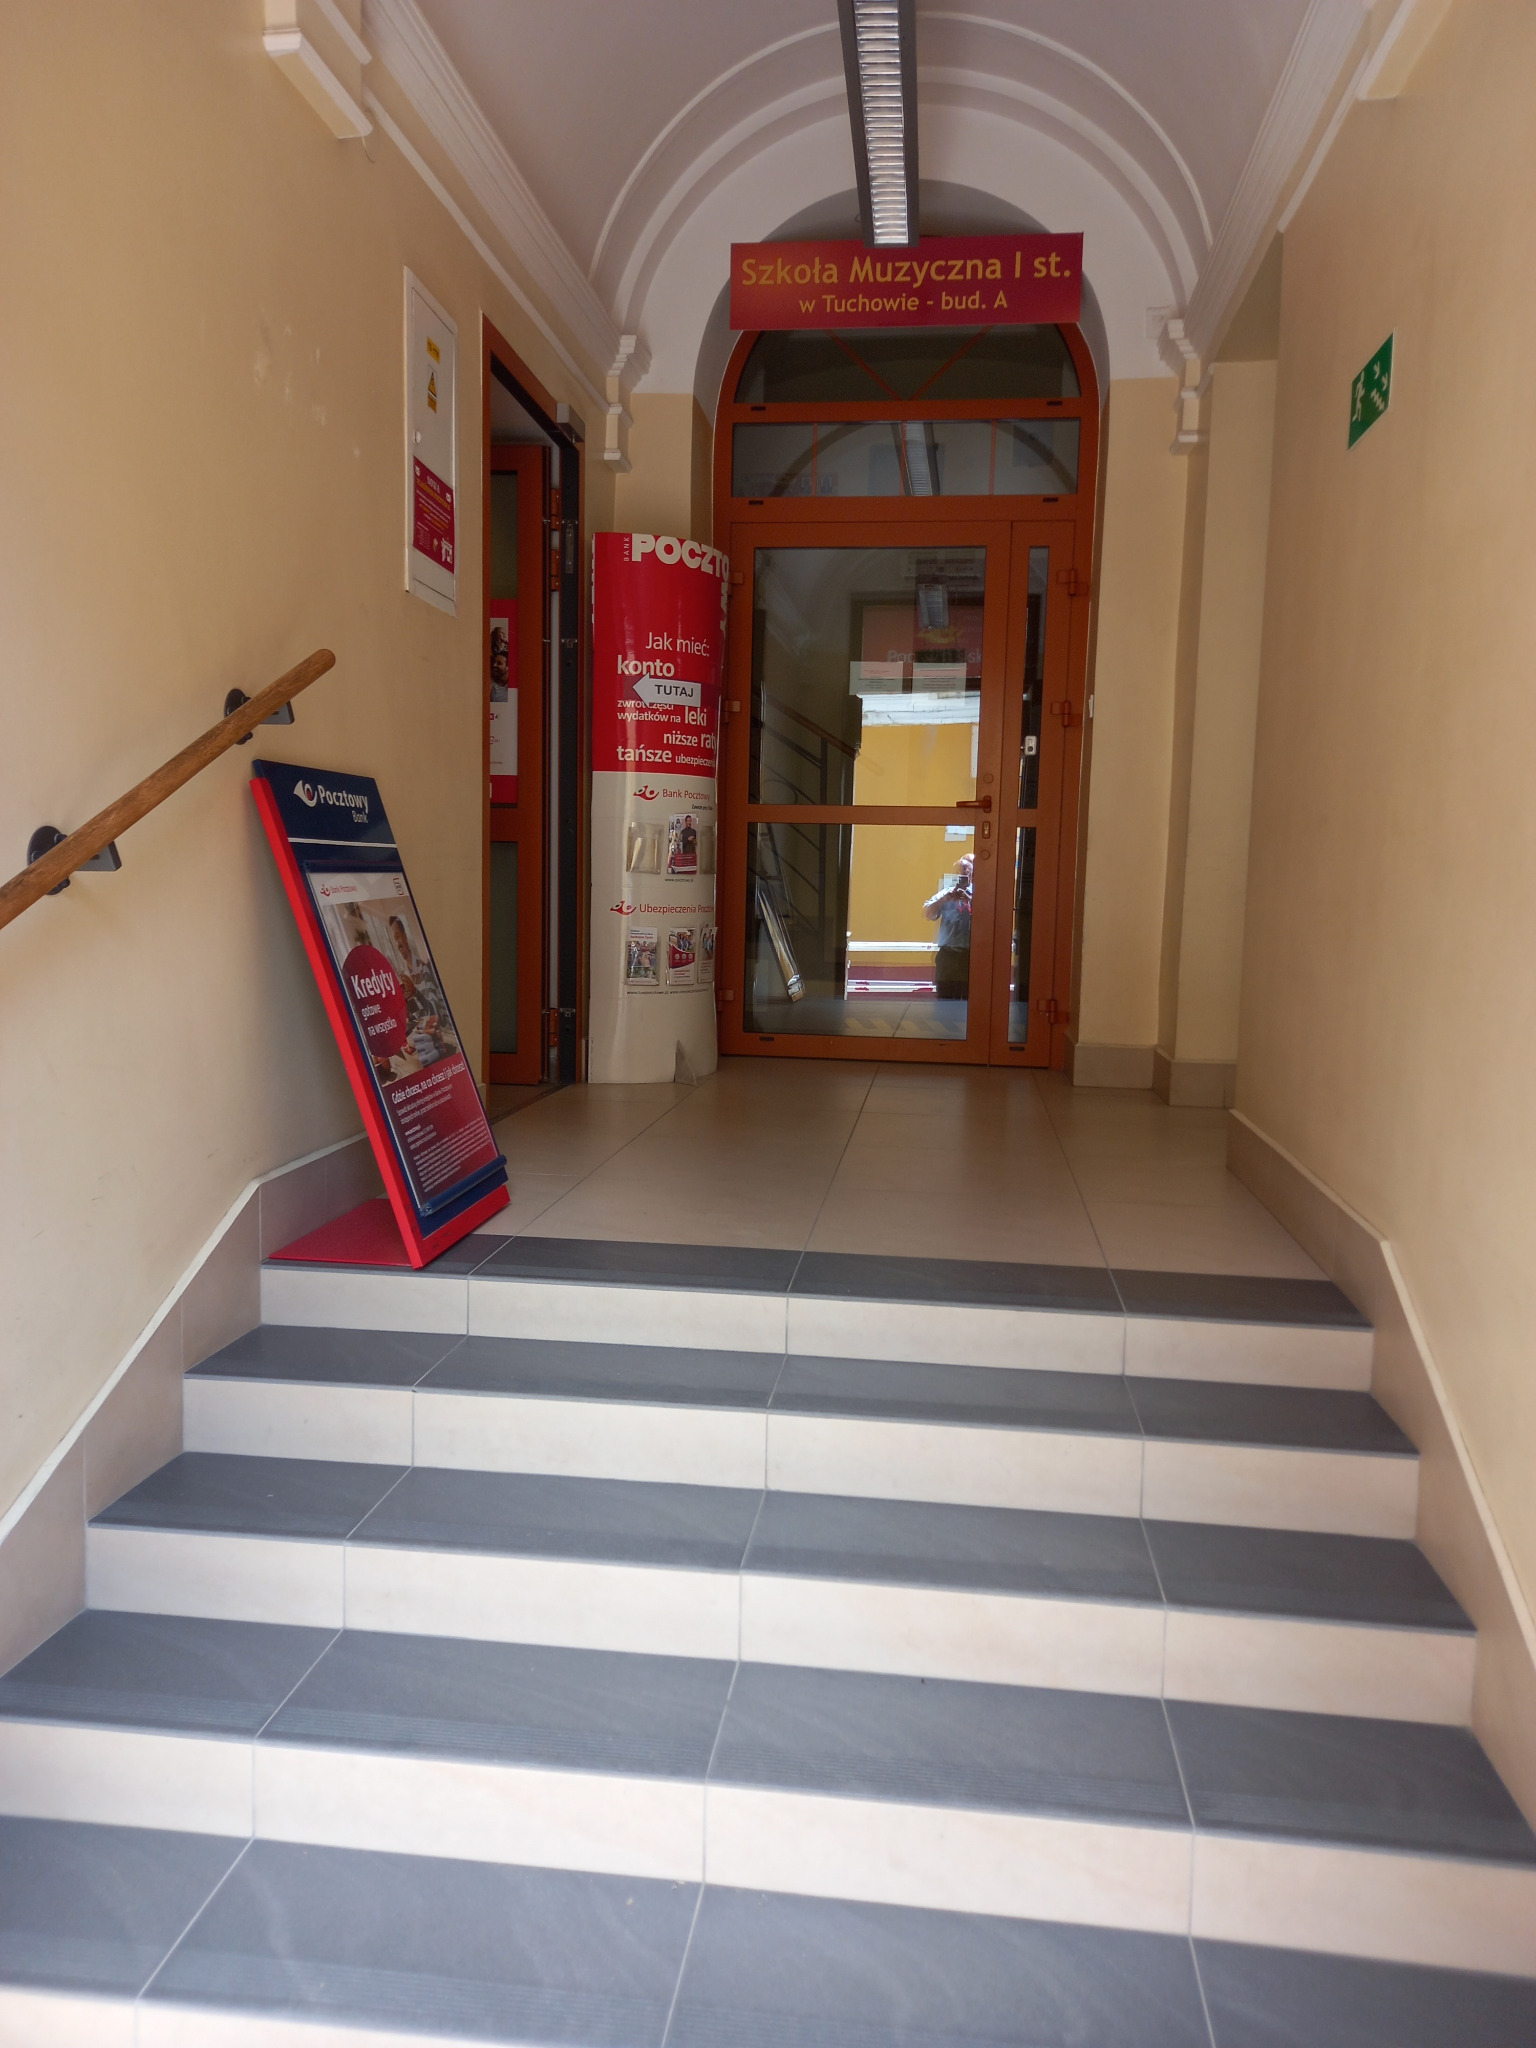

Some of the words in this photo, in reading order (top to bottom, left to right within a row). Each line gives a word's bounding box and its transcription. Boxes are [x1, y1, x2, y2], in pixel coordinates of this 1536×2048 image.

[741, 257, 838, 286] Szkoła
[848, 256, 1002, 289] Muzyczna
[1014, 251, 1021, 279] I
[1033, 252, 1072, 279] st.
[799, 300, 815, 314] w
[821, 292, 920, 314] Tuchowie
[940, 290, 986, 311] bud.
[993, 290, 1008, 309] A
[645, 632, 673, 651] Jak
[676, 636, 710, 657] mieć:
[617, 655, 675, 677] konto
[654, 684, 694, 698] TUTAJ
[617, 710, 669, 723] wydatków
[670, 714, 681, 723] na
[684, 705, 707, 727] leki
[663, 730, 698, 747] niższe
[616, 744, 672, 763] tańsze
[317, 785, 369, 815] Pocztowy
[662, 787, 683, 799] Bank
[684, 790, 710, 802] Pocztowy
[351, 810, 369, 824] Bank
[639, 903, 697, 916] Ubezpieczenia
[350, 968, 396, 1000] Kredyty
